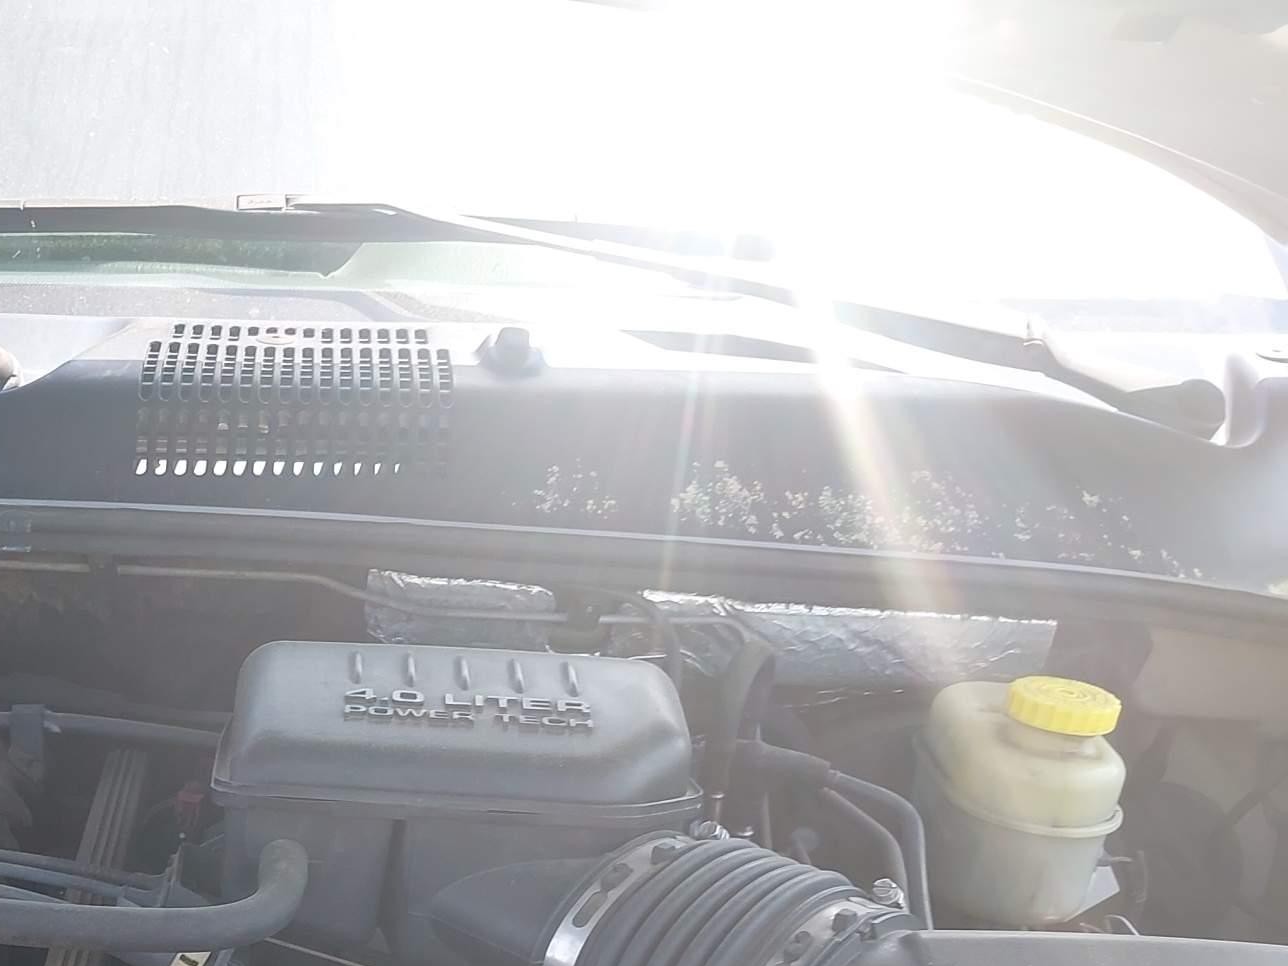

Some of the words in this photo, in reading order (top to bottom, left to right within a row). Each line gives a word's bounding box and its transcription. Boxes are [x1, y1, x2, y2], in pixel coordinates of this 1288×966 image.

[344, 687, 425, 704] 4.0
[444, 692, 593, 714] LITER
[344, 703, 476, 721] POWER
[495, 712, 595, 728] TECH
